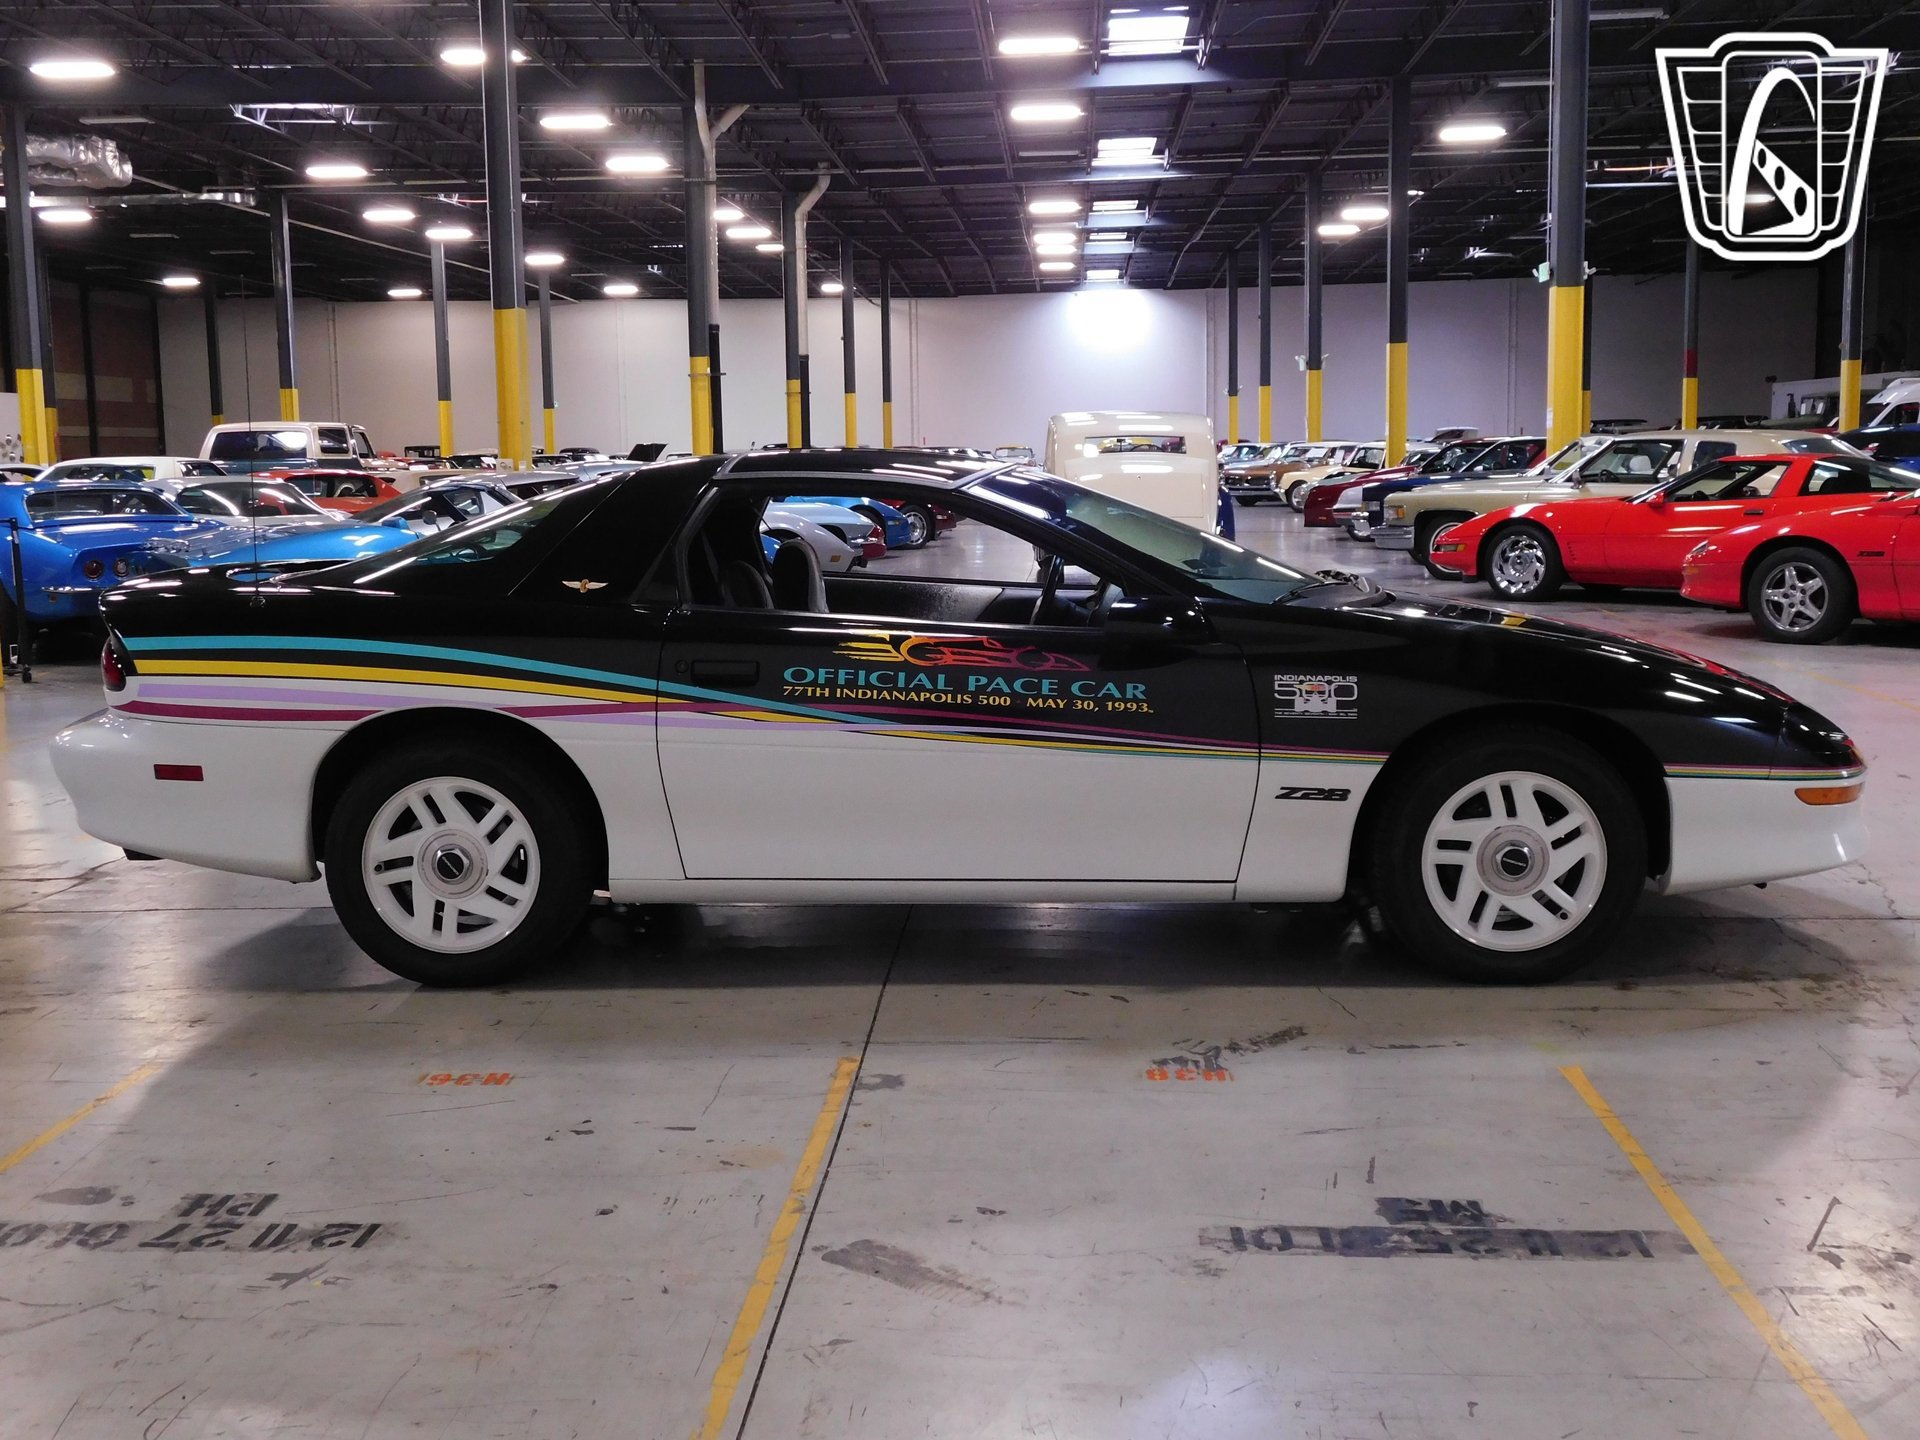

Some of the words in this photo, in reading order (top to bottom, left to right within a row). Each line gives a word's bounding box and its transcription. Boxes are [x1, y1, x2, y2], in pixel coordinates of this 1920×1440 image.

[783, 666, 946, 691] OFFICIAL
[968, 675, 1059, 696] PACE
[1070, 680, 1147, 700] CAR
[1274, 674, 1358, 682] INDIANAPOLIS
[783, 685, 830, 699] 77TH
[836, 687, 972, 705] INDIANAPOLIS
[977, 695, 1011, 707] 500
[1026, 697, 1069, 710] MAY
[1072, 699, 1100, 712] 30,
[1274, 681, 1358, 701] 500
[1274, 786, 1352, 802] Z28
